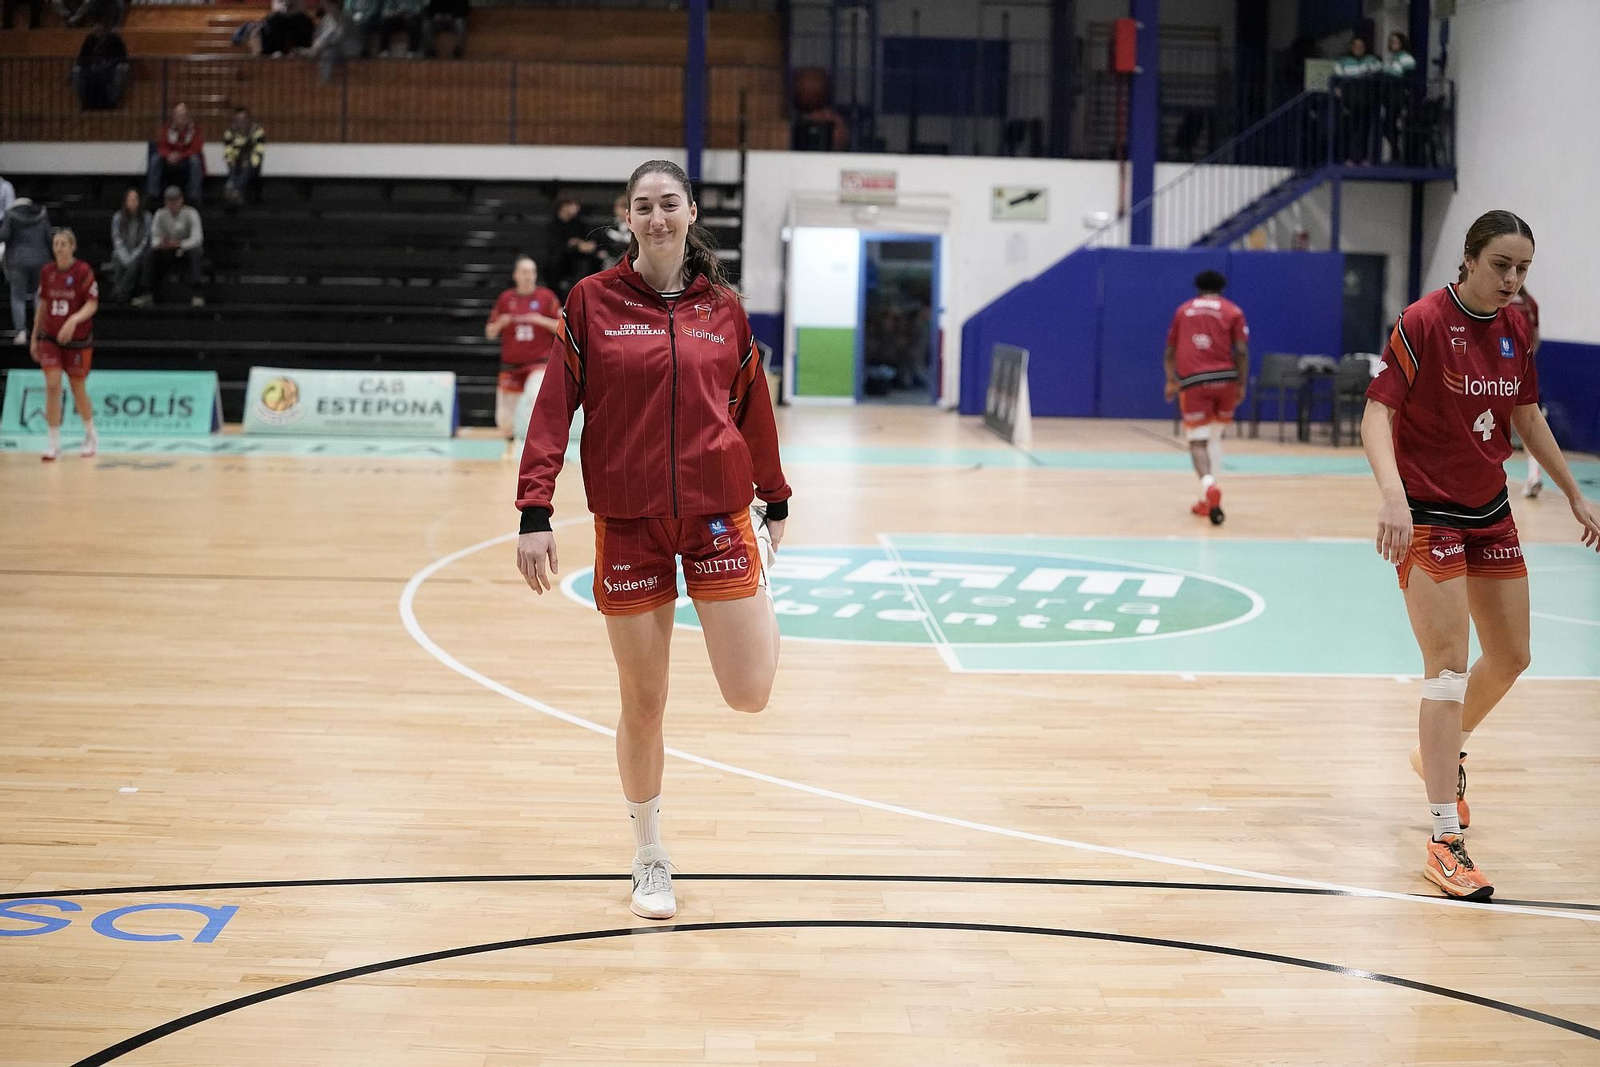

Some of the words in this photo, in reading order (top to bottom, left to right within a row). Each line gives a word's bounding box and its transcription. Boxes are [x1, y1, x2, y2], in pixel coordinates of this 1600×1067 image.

[692, 328, 726, 345] lointek
[359, 377, 405, 394] CAB
[1465, 374, 1522, 396] lointek
[104, 388, 194, 418] SOLÍS
[316, 396, 445, 416] ESTEPONA
[1472, 408, 1496, 442] 4
[1483, 545, 1522, 560] surn
[612, 563, 631, 571] vive
[694, 555, 749, 575] surne
